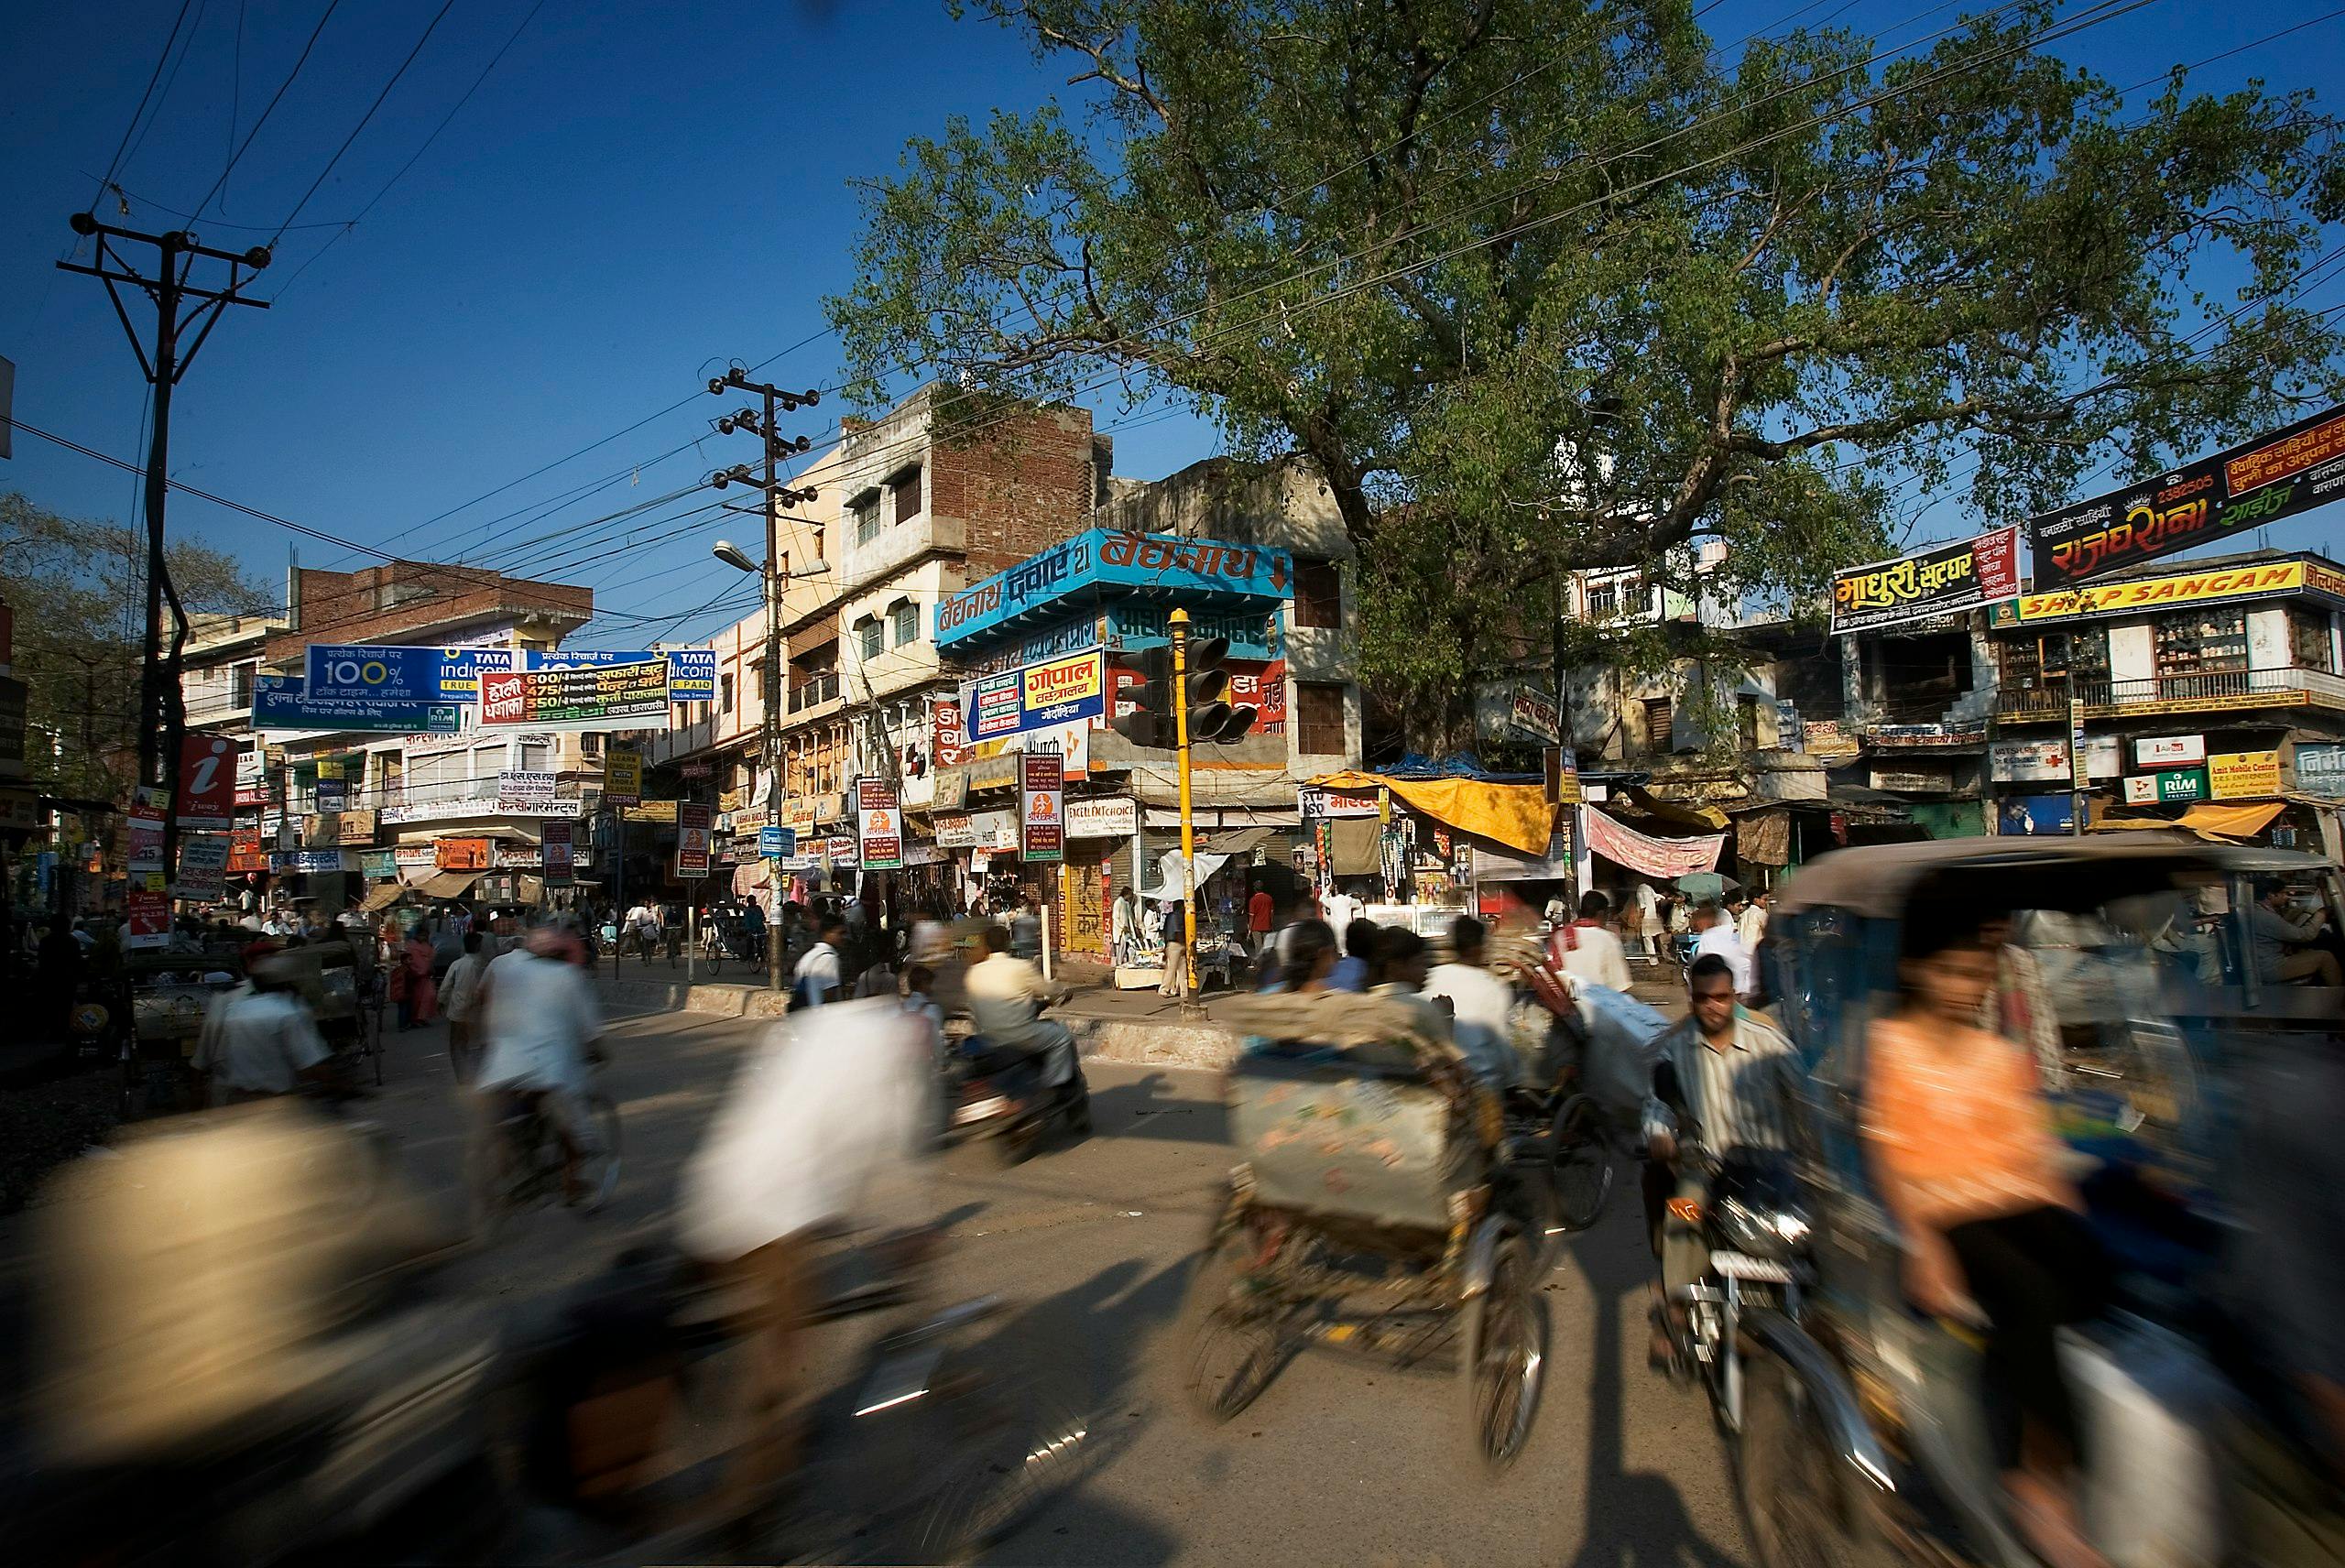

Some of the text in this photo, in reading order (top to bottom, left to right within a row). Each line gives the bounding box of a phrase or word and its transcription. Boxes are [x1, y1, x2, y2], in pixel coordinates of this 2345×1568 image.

[2266, 463, 2284, 479] का
[1074, 546, 1091, 574] 21
[1835, 560, 1921, 609] माधुरी
[2129, 565, 2294, 604] SANGAM
[326, 648, 356, 659] प्रत्येक
[387, 650, 403, 660] पर
[474, 652, 512, 665] TATA
[541, 651, 570, 661] प्रत्येक
[600, 652, 615, 661] पर
[681, 653, 714, 664] TATA
[1028, 659, 1096, 691] गोपाल
[443, 681, 473, 690] TRUE
[683, 681, 711, 690] PAID
[610, 754, 637, 762] LEARN
[608, 762, 638, 770] ENGLISH
[2211, 763, 2276, 775] Amit Mobile Center
[606, 785, 638, 794] CLASSES
[2165, 779, 2198, 791] RIM
[2167, 791, 2197, 800] PREPAID
[1069, 806, 1106, 819] EXCELLENT
[1106, 805, 1134, 817] CHOICE
